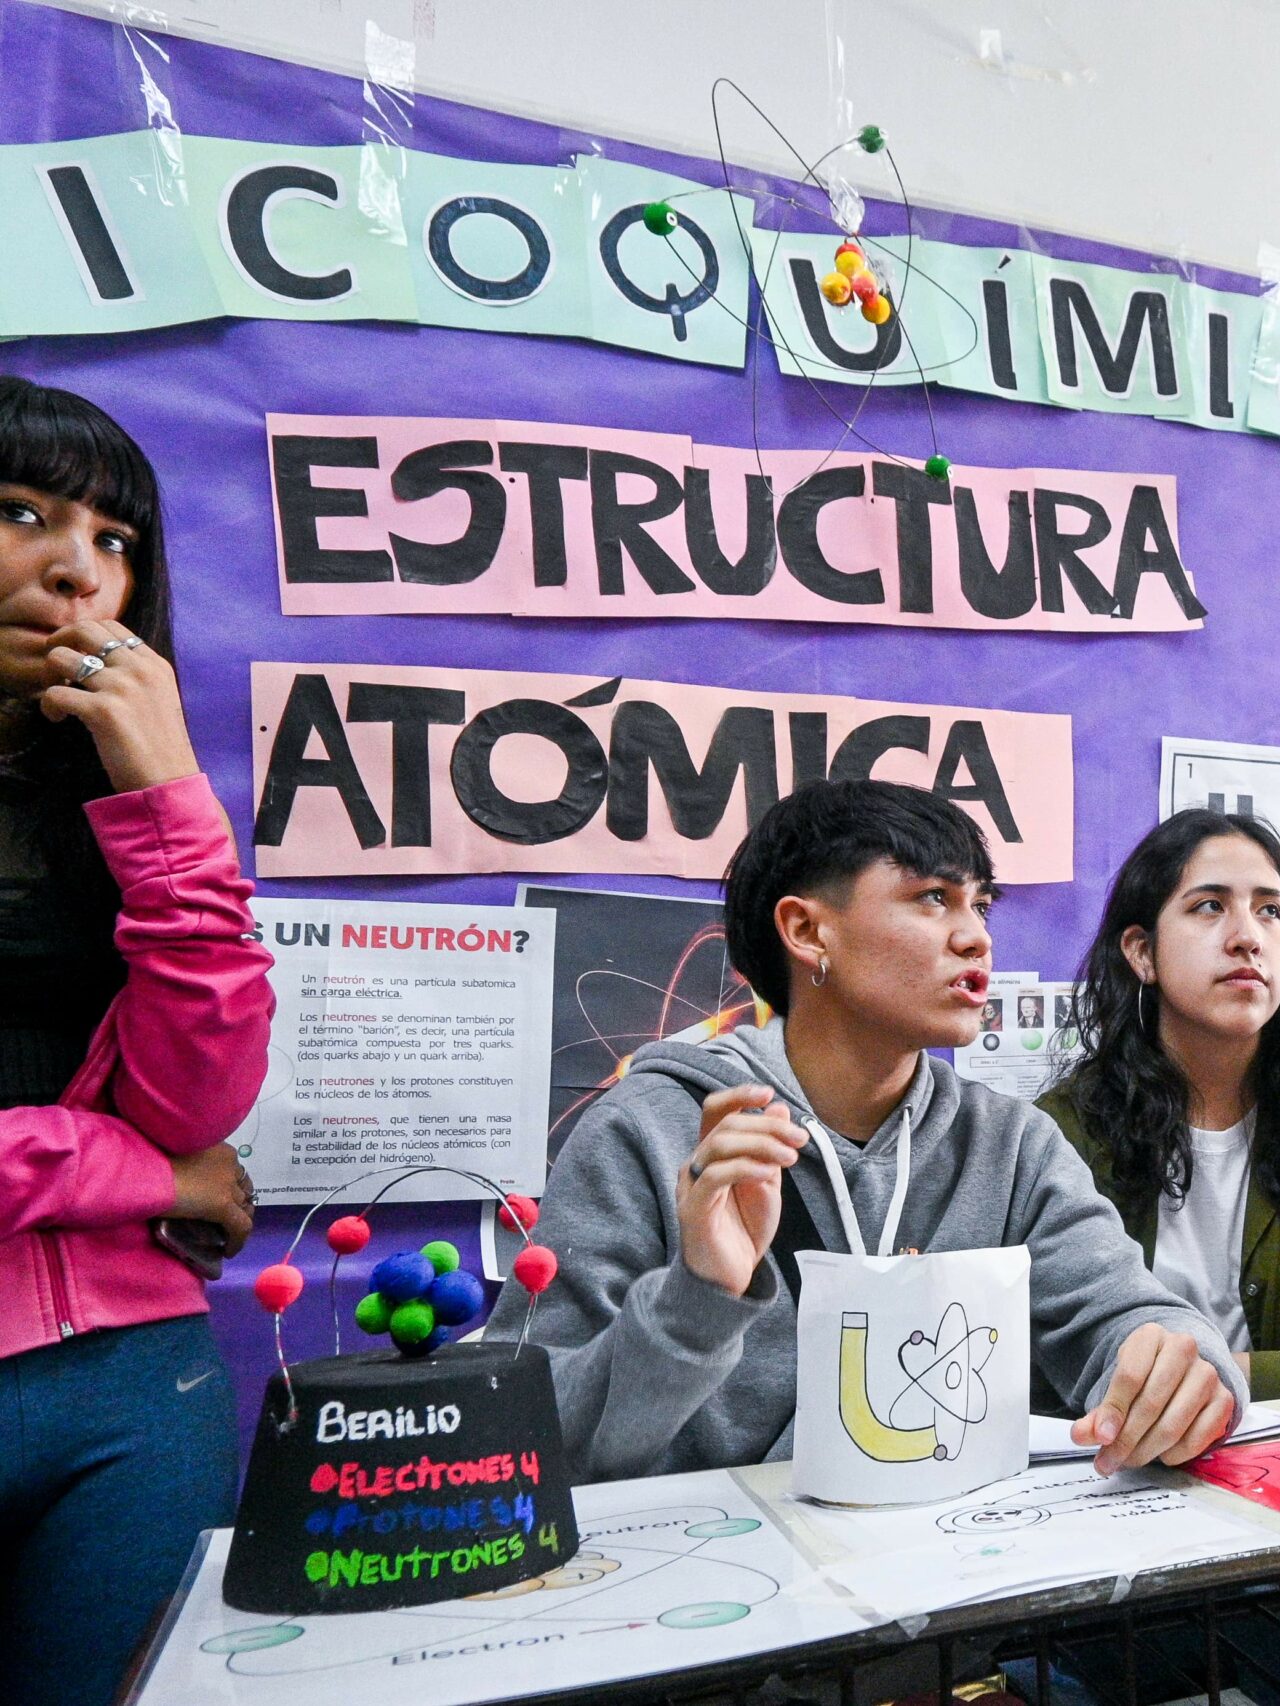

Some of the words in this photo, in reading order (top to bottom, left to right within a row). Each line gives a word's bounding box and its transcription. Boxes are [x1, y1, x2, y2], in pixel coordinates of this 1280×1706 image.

[271, 433, 1209, 621] ESTRUCTURA
[1187, 762, 1194, 779] 1
[275, 922, 330, 947] UN
[341, 922, 531, 953] NEUTRÓN?
[302, 975, 316, 984] Un
[323, 976, 365, 985] neutrón
[390, 978, 408, 986] una
[301, 988, 317, 996] sin
[321, 988, 350, 999] carga
[356, 988, 402, 998] eléctrica.
[300, 1013, 317, 1022] Los
[323, 1014, 376, 1022] neutrones
[398, 1015, 451, 1023] denominan
[456, 1016, 494, 1024] también
[499, 1017, 514, 1026] por
[299, 1026, 308, 1034] el
[313, 1025, 353, 1034] término
[406, 1028, 417, 1036] es
[452, 1028, 469, 1036] una
[299, 1038, 358, 1047] subatómica
[366, 1040, 421, 1050] compuesta
[429, 1040, 445, 1050] por
[453, 1039, 471, 1048] tres
[480, 1040, 514, 1050] quarks.
[298, 1051, 319, 1061] (dos
[324, 1051, 359, 1062] quarks
[363, 1052, 390, 1062] abajo
[420, 1052, 447, 1063] quark
[451, 1052, 484, 1061] arriba).
[296, 1077, 314, 1086] Los
[320, 1077, 374, 1086] neutrones
[392, 1077, 405, 1086] los
[410, 1078, 454, 1087] protones
[459, 1077, 513, 1087] constituyen
[296, 1090, 310, 1099] los
[314, 1090, 354, 1099] núcleos
[358, 1090, 370, 1099] de
[375, 1090, 388, 1098] los
[392, 1089, 432, 1098] átomos.
[294, 1116, 312, 1125] Los
[322, 1116, 380, 1126] neutrones,
[390, 1115, 409, 1126] que
[419, 1115, 449, 1123] tienen
[459, 1115, 476, 1123] una
[487, 1115, 511, 1123] masa
[293, 1129, 326, 1138] similar
[342, 1128, 356, 1137] los
[361, 1128, 408, 1140] protones,
[413, 1128, 430, 1136] son
[435, 1127, 486, 1136] necesarios
[490, 1128, 511, 1137] para
[293, 1143, 301, 1151] la
[306, 1141, 361, 1151] estabilidad
[366, 1141, 378, 1149] de
[383, 1141, 397, 1149] los
[401, 1140, 439, 1149] núcleos
[444, 1140, 486, 1148] atómicos
[491, 1139, 510, 1149] (con
[292, 1155, 300, 1164] la
[305, 1154, 356, 1166] excepción
[360, 1154, 375, 1163] del
[380, 1153, 436, 1164] hidrógeno).
[520, 1450, 540, 1486] 4
[579, 1519, 690, 1537] eutron
[538, 1521, 560, 1556] 4
[391, 1633, 565, 1667] Electron
